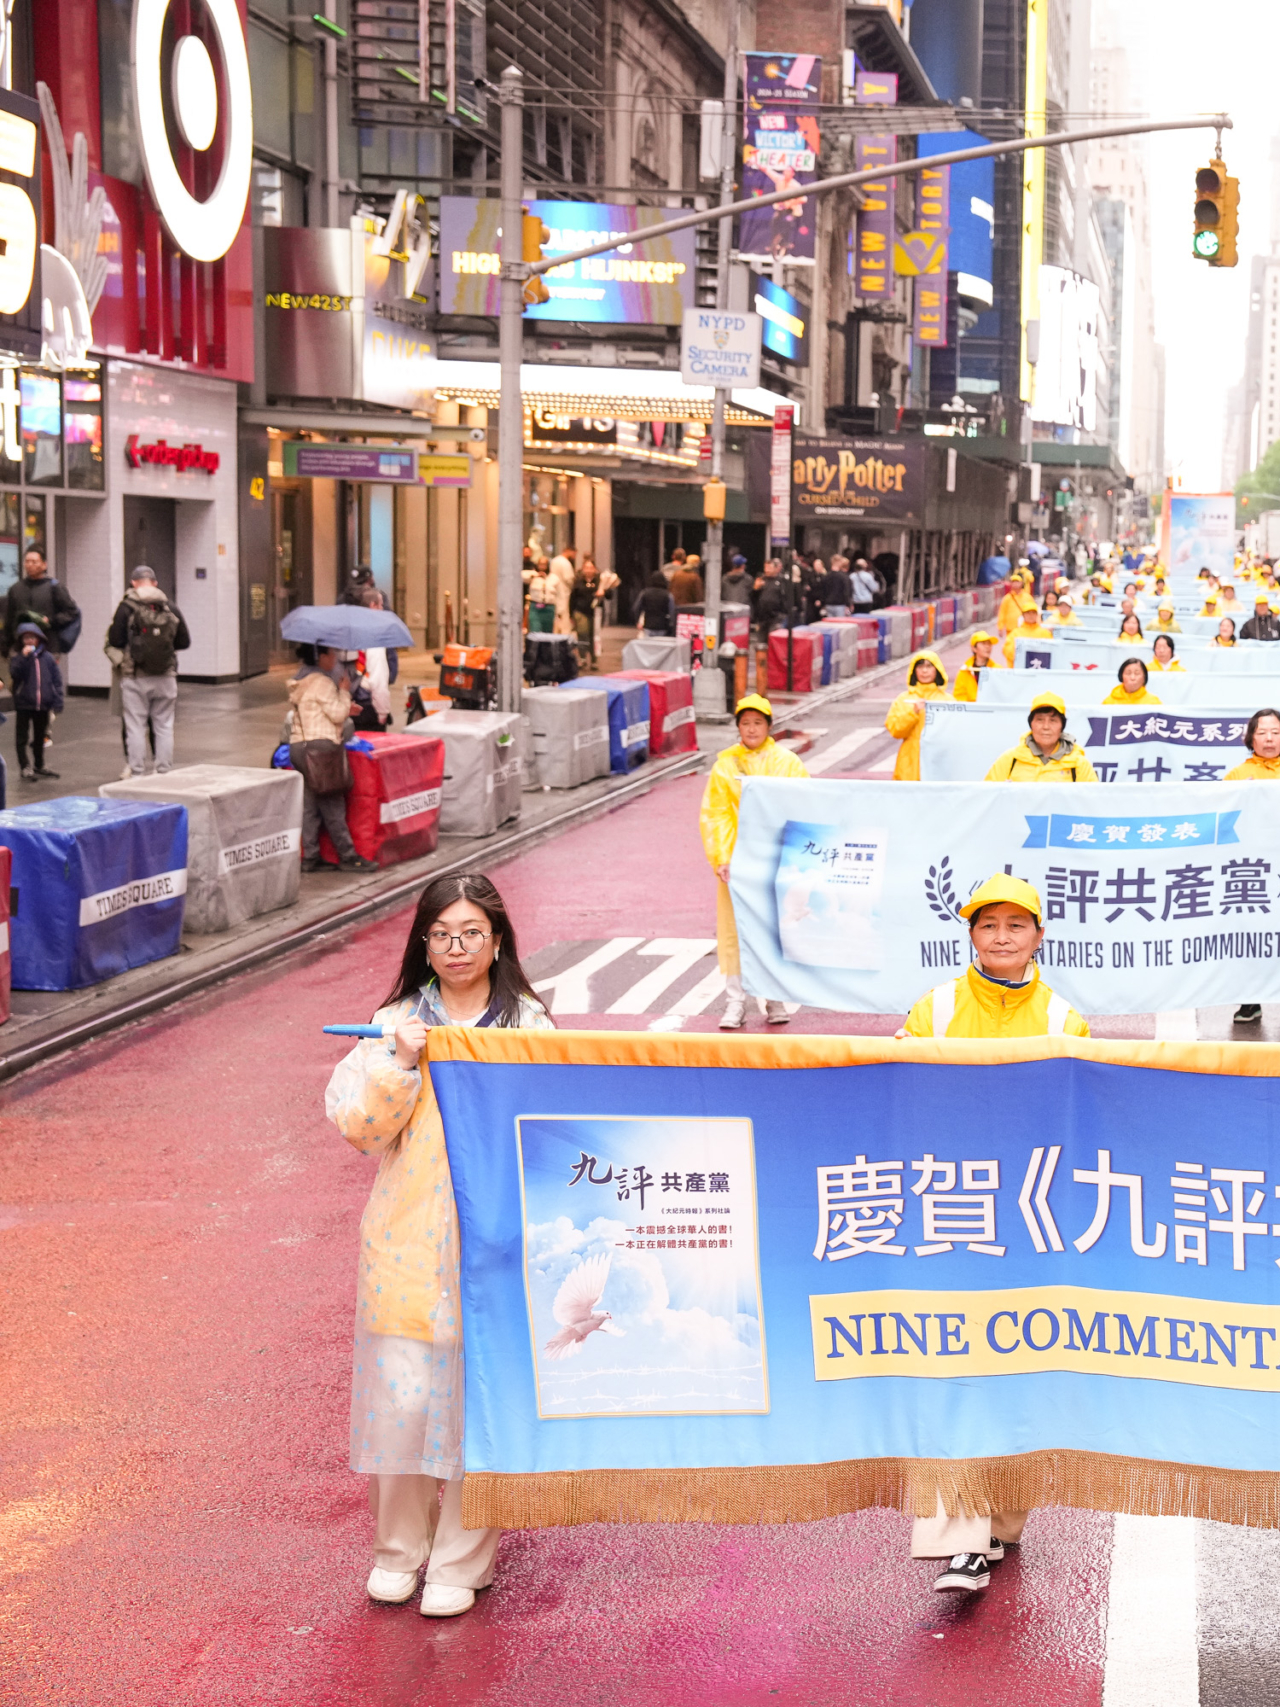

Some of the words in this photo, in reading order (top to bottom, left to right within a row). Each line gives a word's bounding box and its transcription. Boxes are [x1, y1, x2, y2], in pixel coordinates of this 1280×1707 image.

[761, 115, 785, 129] NEW
[755, 130, 804, 149] VICTORY
[752, 151, 812, 167] HEATER
[861, 231, 887, 291] NEW
[699, 315, 746, 331] NYPD
[919, 289, 941, 340] NEW
[688, 345, 752, 364] SECURITY
[690, 360, 748, 378] CAMERA
[793, 455, 838, 493] arry
[838, 450, 906, 500] Potter
[224, 846, 253, 867] TIMES
[255, 834, 290, 859] SQUARE
[97, 890, 127, 917] TIMES
[920, 940, 961, 968] NINE
[970, 940, 1103, 968] NTARIES
[1112, 941, 1134, 968] ON
[1143, 939, 1173, 967] THE
[823, 1311, 970, 1359] NINE
